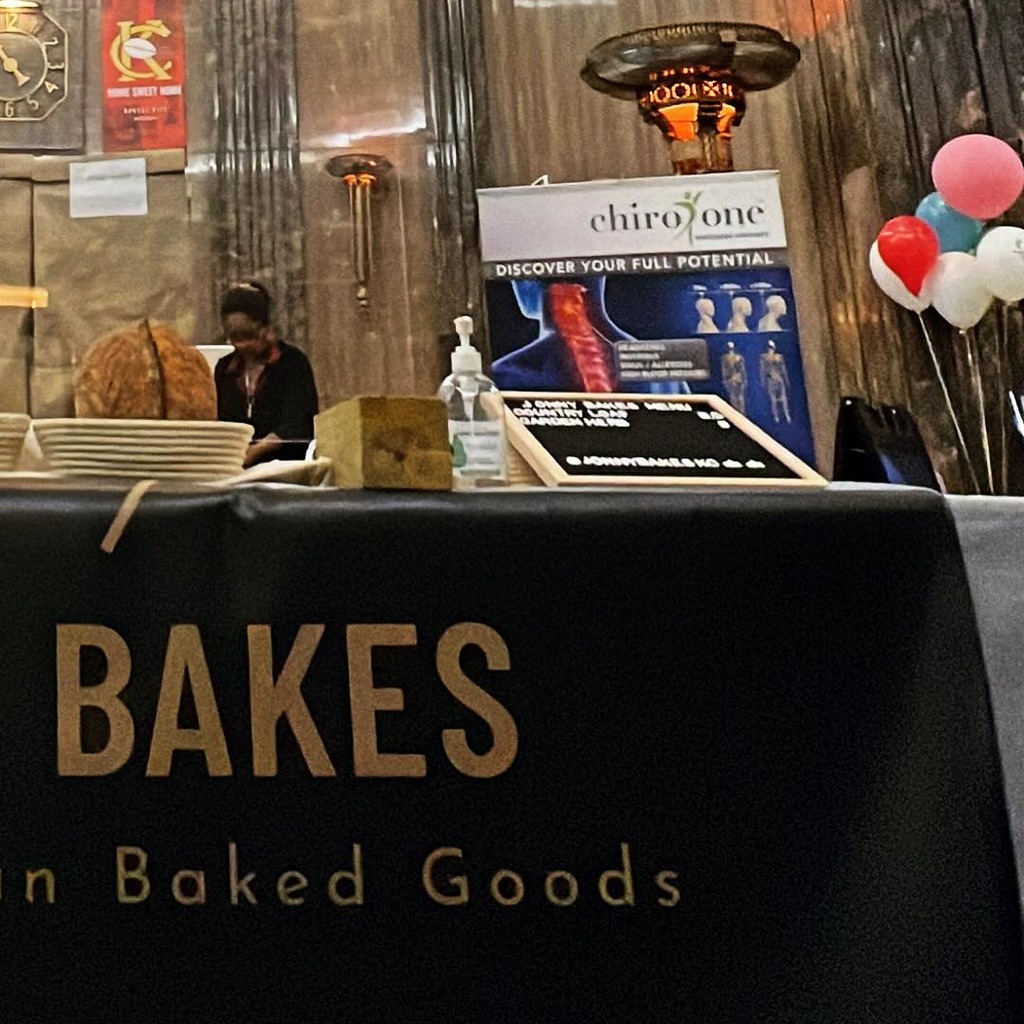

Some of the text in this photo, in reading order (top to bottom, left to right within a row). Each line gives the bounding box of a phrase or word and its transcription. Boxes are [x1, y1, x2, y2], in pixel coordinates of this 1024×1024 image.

[43, 80, 59, 94] 4
[4, 100, 16, 118] 6
[589, 202, 765, 234] chiro one
[495, 252, 774, 277] DISCOVER YOUR FULL POTENTIAL
[55, 621, 520, 778] BAKES
[114, 842, 365, 906] Baked
[421, 842, 682, 907] Goods
